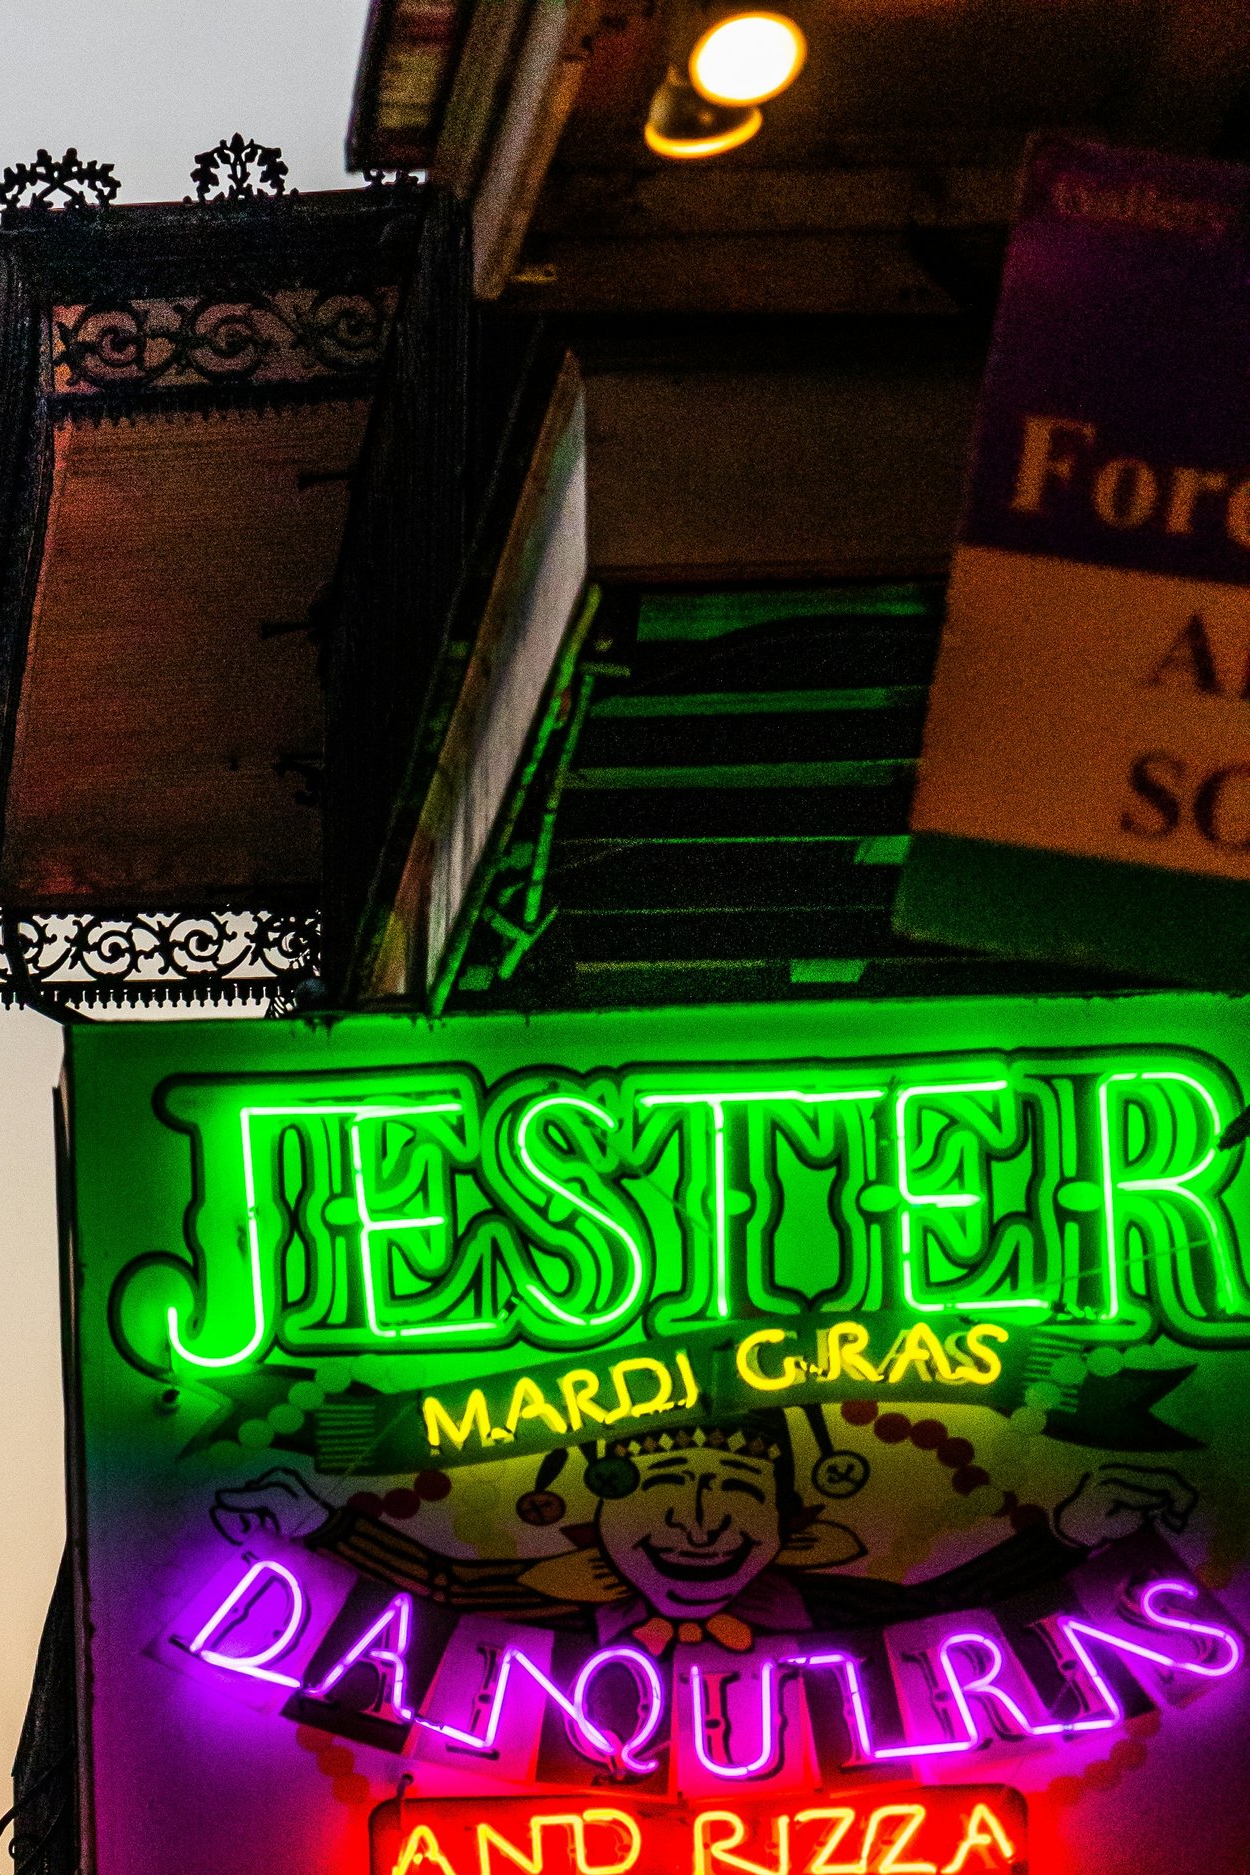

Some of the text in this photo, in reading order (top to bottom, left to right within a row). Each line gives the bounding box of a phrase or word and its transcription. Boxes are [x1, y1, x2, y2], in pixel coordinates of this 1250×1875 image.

[140, 1058, 1250, 1372] JESTER
[422, 1320, 1010, 1457] MARDI GRAS
